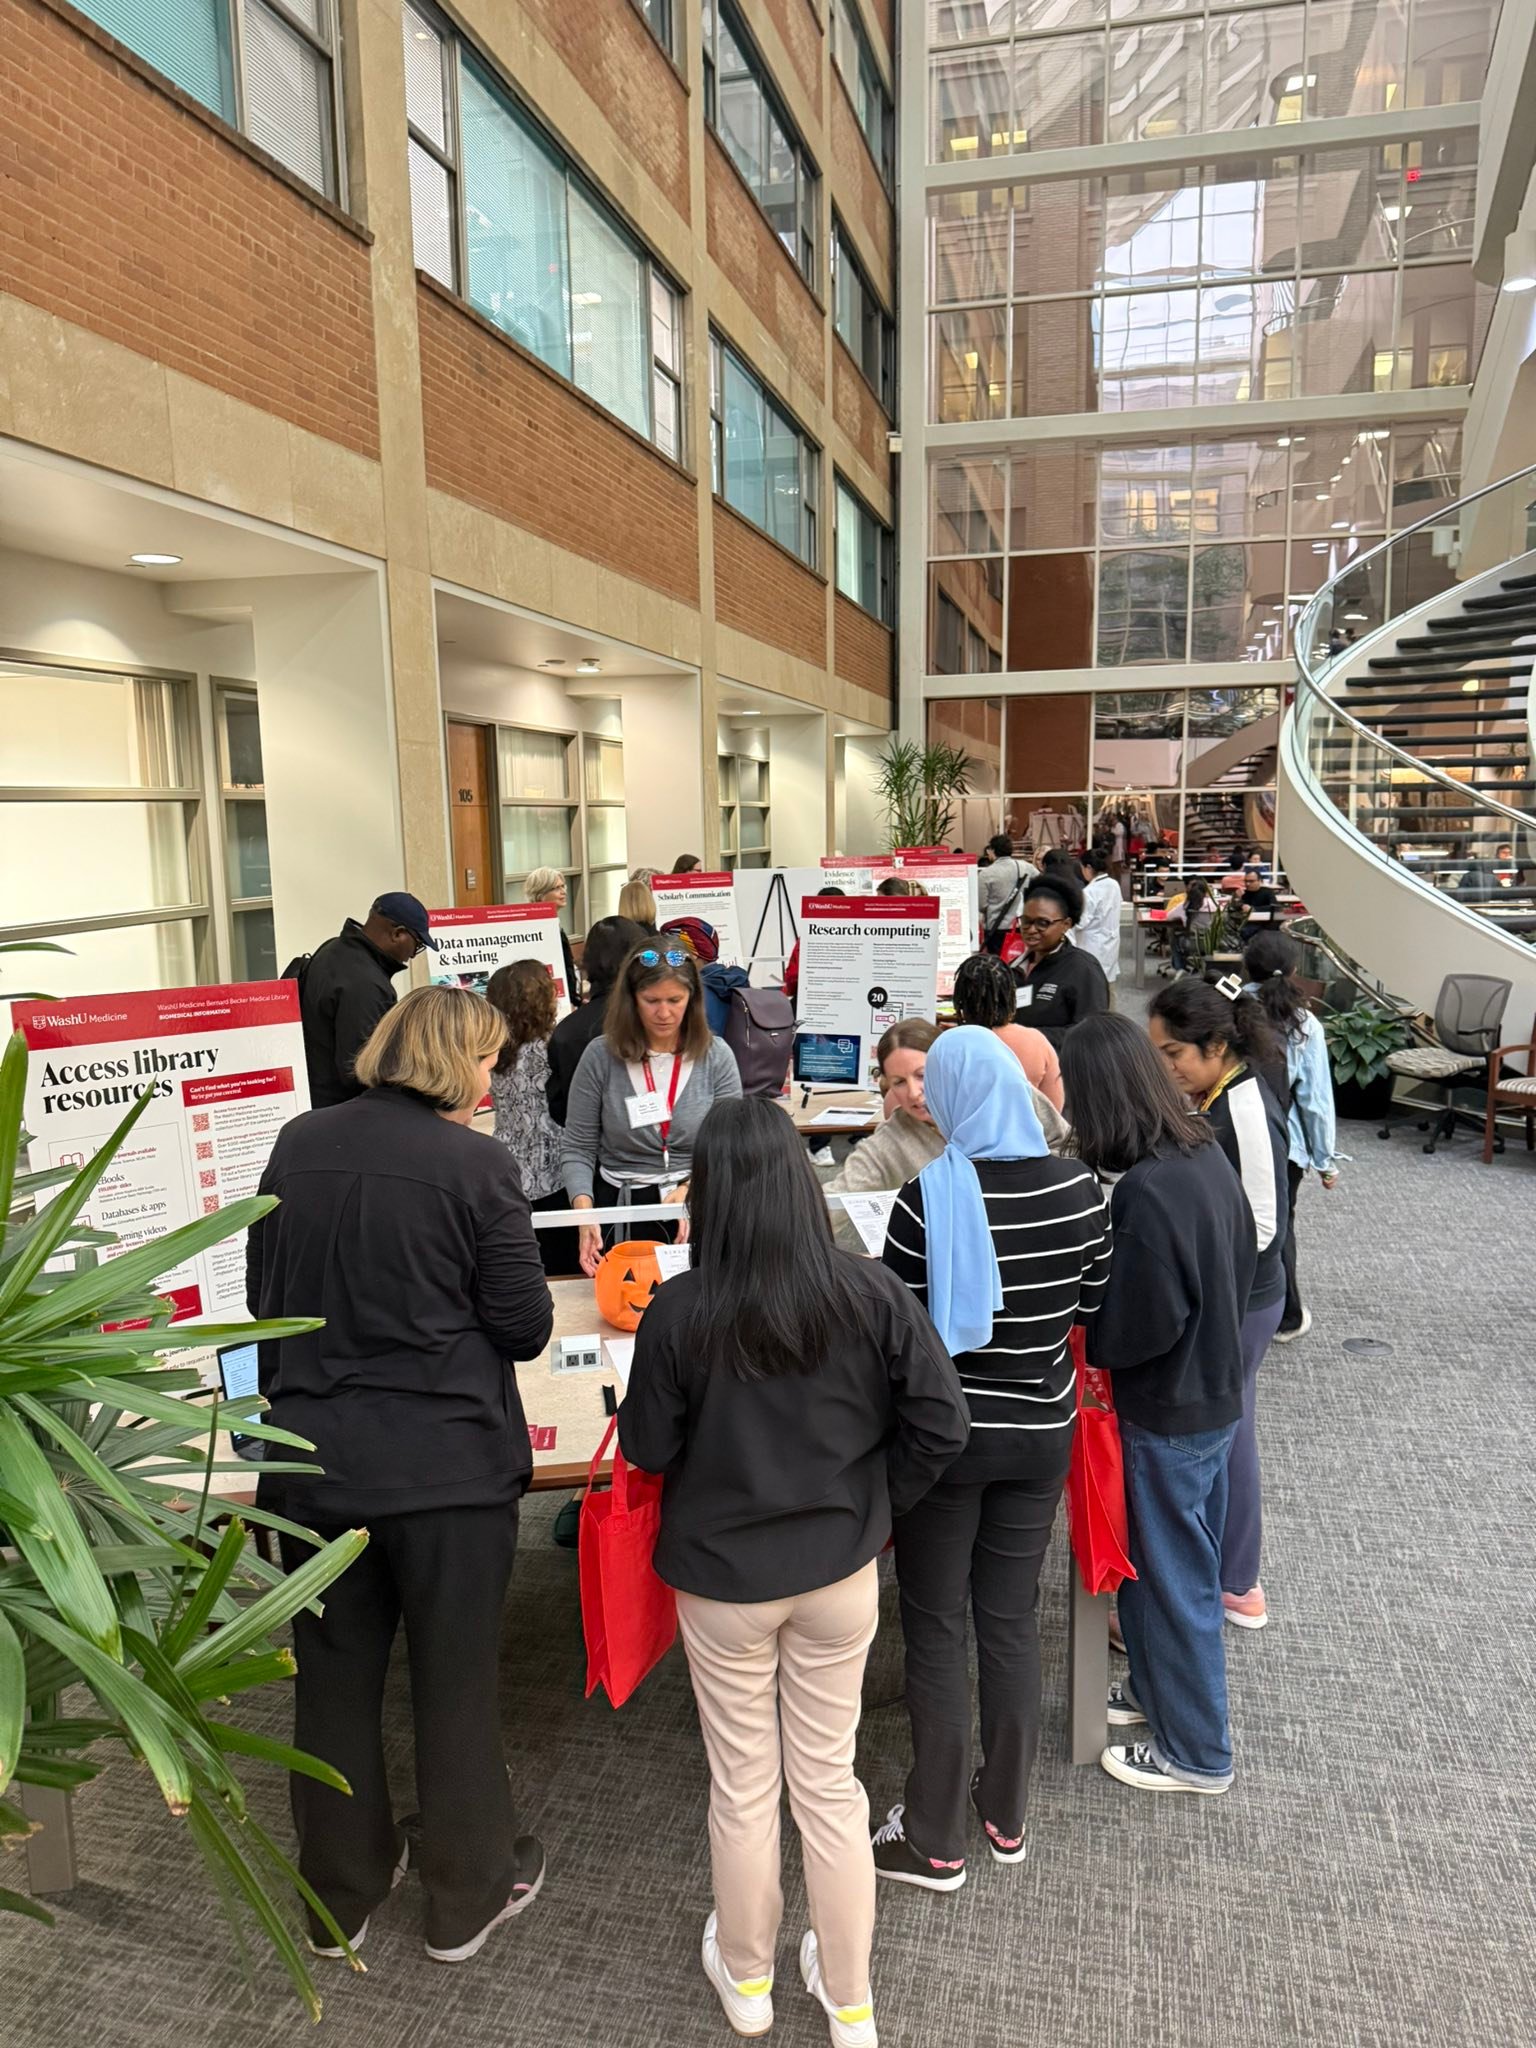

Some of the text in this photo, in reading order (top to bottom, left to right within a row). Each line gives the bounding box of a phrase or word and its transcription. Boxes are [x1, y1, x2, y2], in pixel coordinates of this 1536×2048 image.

[824, 870, 855, 878] Evidence
[824, 878, 856, 886] synthesis
[658, 890, 731, 902] Scholarly Communication
[809, 923, 931, 939] Research computing
[434, 931, 544, 950] Data management
[439, 950, 499, 966] & sharing
[157, 993, 290, 1011] WashU Medicine Bernard Becker Medical Library
[871, 993, 884, 1002] 20
[47, 1012, 128, 1027] WashU Medicine
[159, 1008, 231, 1020] BIOMEDICAL INFORMATION
[40, 1048, 219, 1088] Access library
[189, 1085, 205, 1094] Can't
[217, 1081, 230, 1090] what
[230, 1080, 247, 1090] you're
[247, 1077, 266, 1086] looking
[266, 1075, 277, 1083] for?
[43, 1079, 174, 1115] resources
[204, 1091, 213, 1100] got
[213, 1090, 223, 1099] you
[101, 1206, 140, 1221] Databases
[140, 1203, 148, 1213] &
[149, 1200, 167, 1213] apps
[143, 1225, 167, 1236] videos
